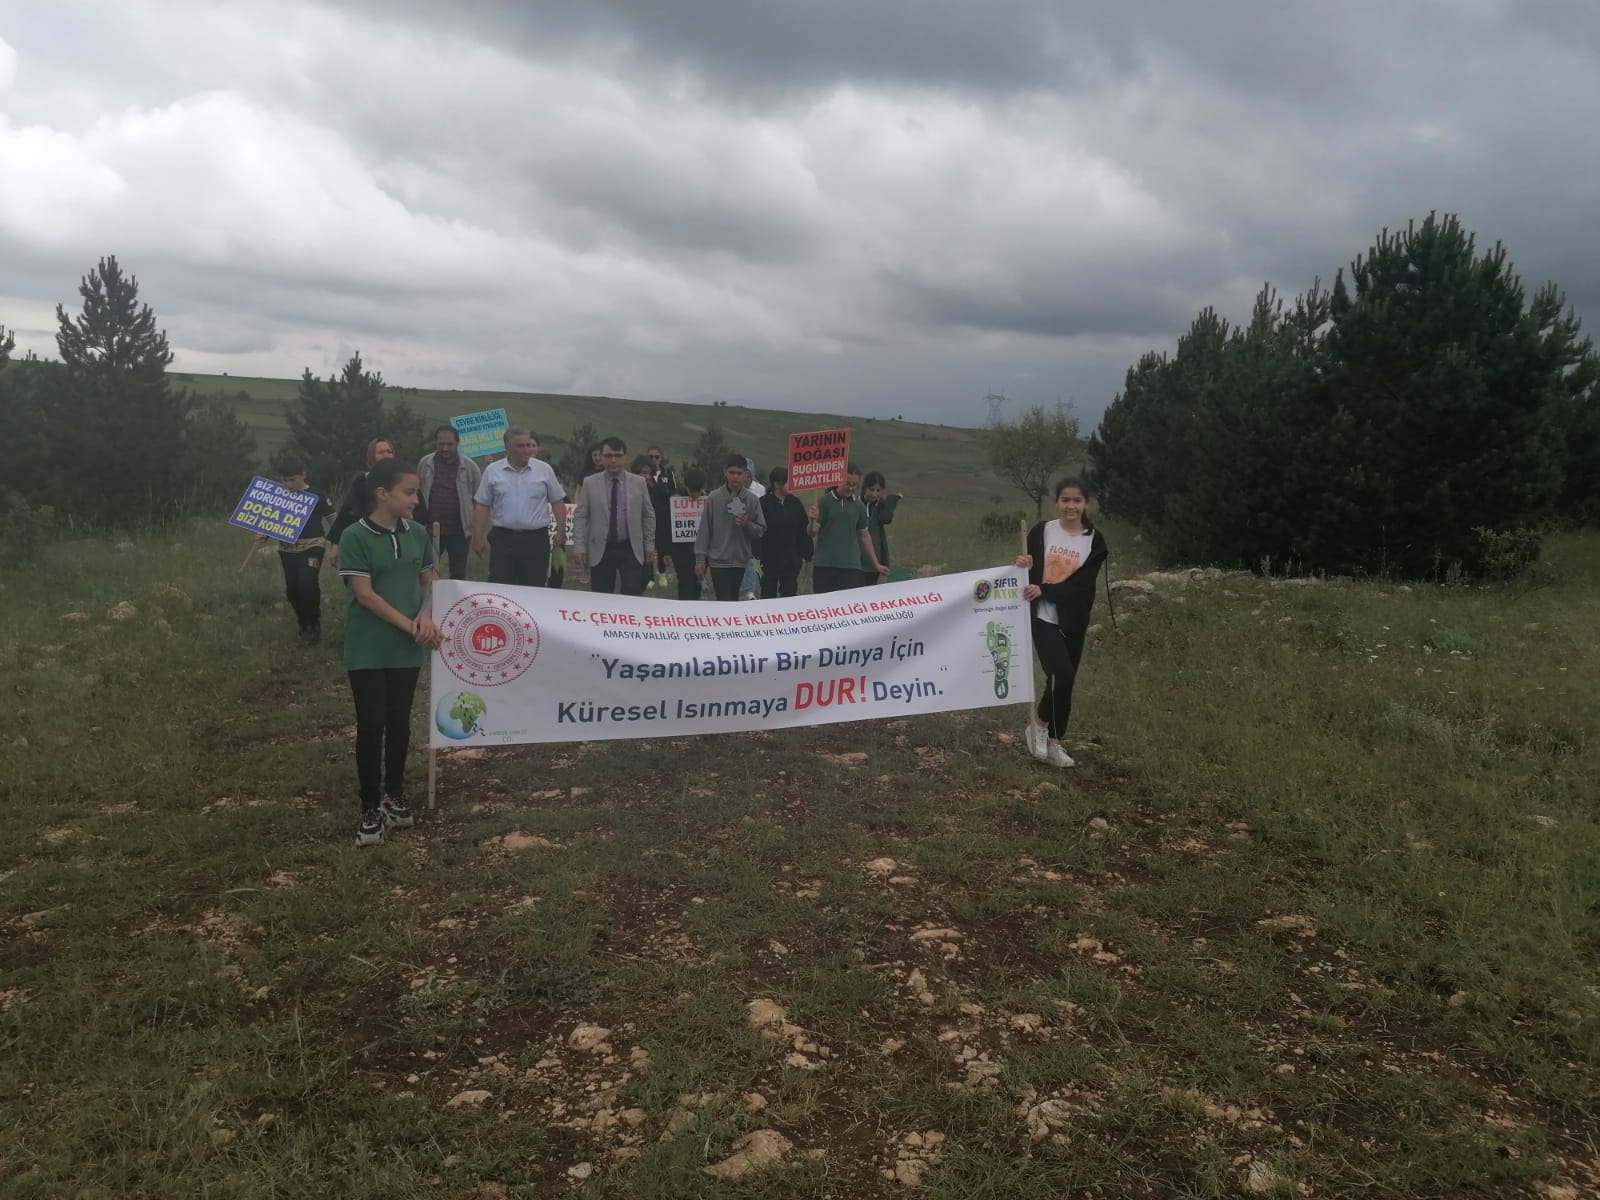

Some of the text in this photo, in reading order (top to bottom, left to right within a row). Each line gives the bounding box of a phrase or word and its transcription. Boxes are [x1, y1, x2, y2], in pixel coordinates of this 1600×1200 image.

[794, 432, 846, 448] YARININ
[793, 447, 845, 462] DOĞASI
[792, 460, 845, 475] BUGÜNDEN
[792, 472, 844, 487] YARATILIR.
[249, 489, 308, 515] KORUDUKÇA
[255, 480, 314, 505] BİZ DOĞAYI
[236, 512, 294, 538] BİZİ KORUR.
[243, 500, 301, 527] DOĞA DA
[1050, 545, 1080, 560] FLORIDA
[993, 588, 1018, 600] ATIK
[559, 592, 943, 629] T.C. ÇEVRE, ŞEHİRCİLİK VE İKLİM DEĞİŞİKLİĞİ BAKANLIĞI
[603, 630, 641, 640] AMASYA
[643, 630, 680, 641] VALİLİĞİ
[684, 632, 714, 642] ÇEVRE,
[715, 630, 762, 641] ŞEHİRCİLİK
[763, 629, 776, 637] VE
[776, 626, 800, 636] İKLİM
[801, 617, 850, 633] DEĞİŞİKLİĞİ
[860, 610, 914, 625] MÜDÜRLÜĞÜ
[776, 651, 812, 671] Bir
[819, 645, 883, 667] Dünya
[890, 636, 924, 661] İçin
[558, 700, 667, 723] Küresel
[677, 697, 788, 718] Isınmaya
[794, 675, 867, 710] DUR!
